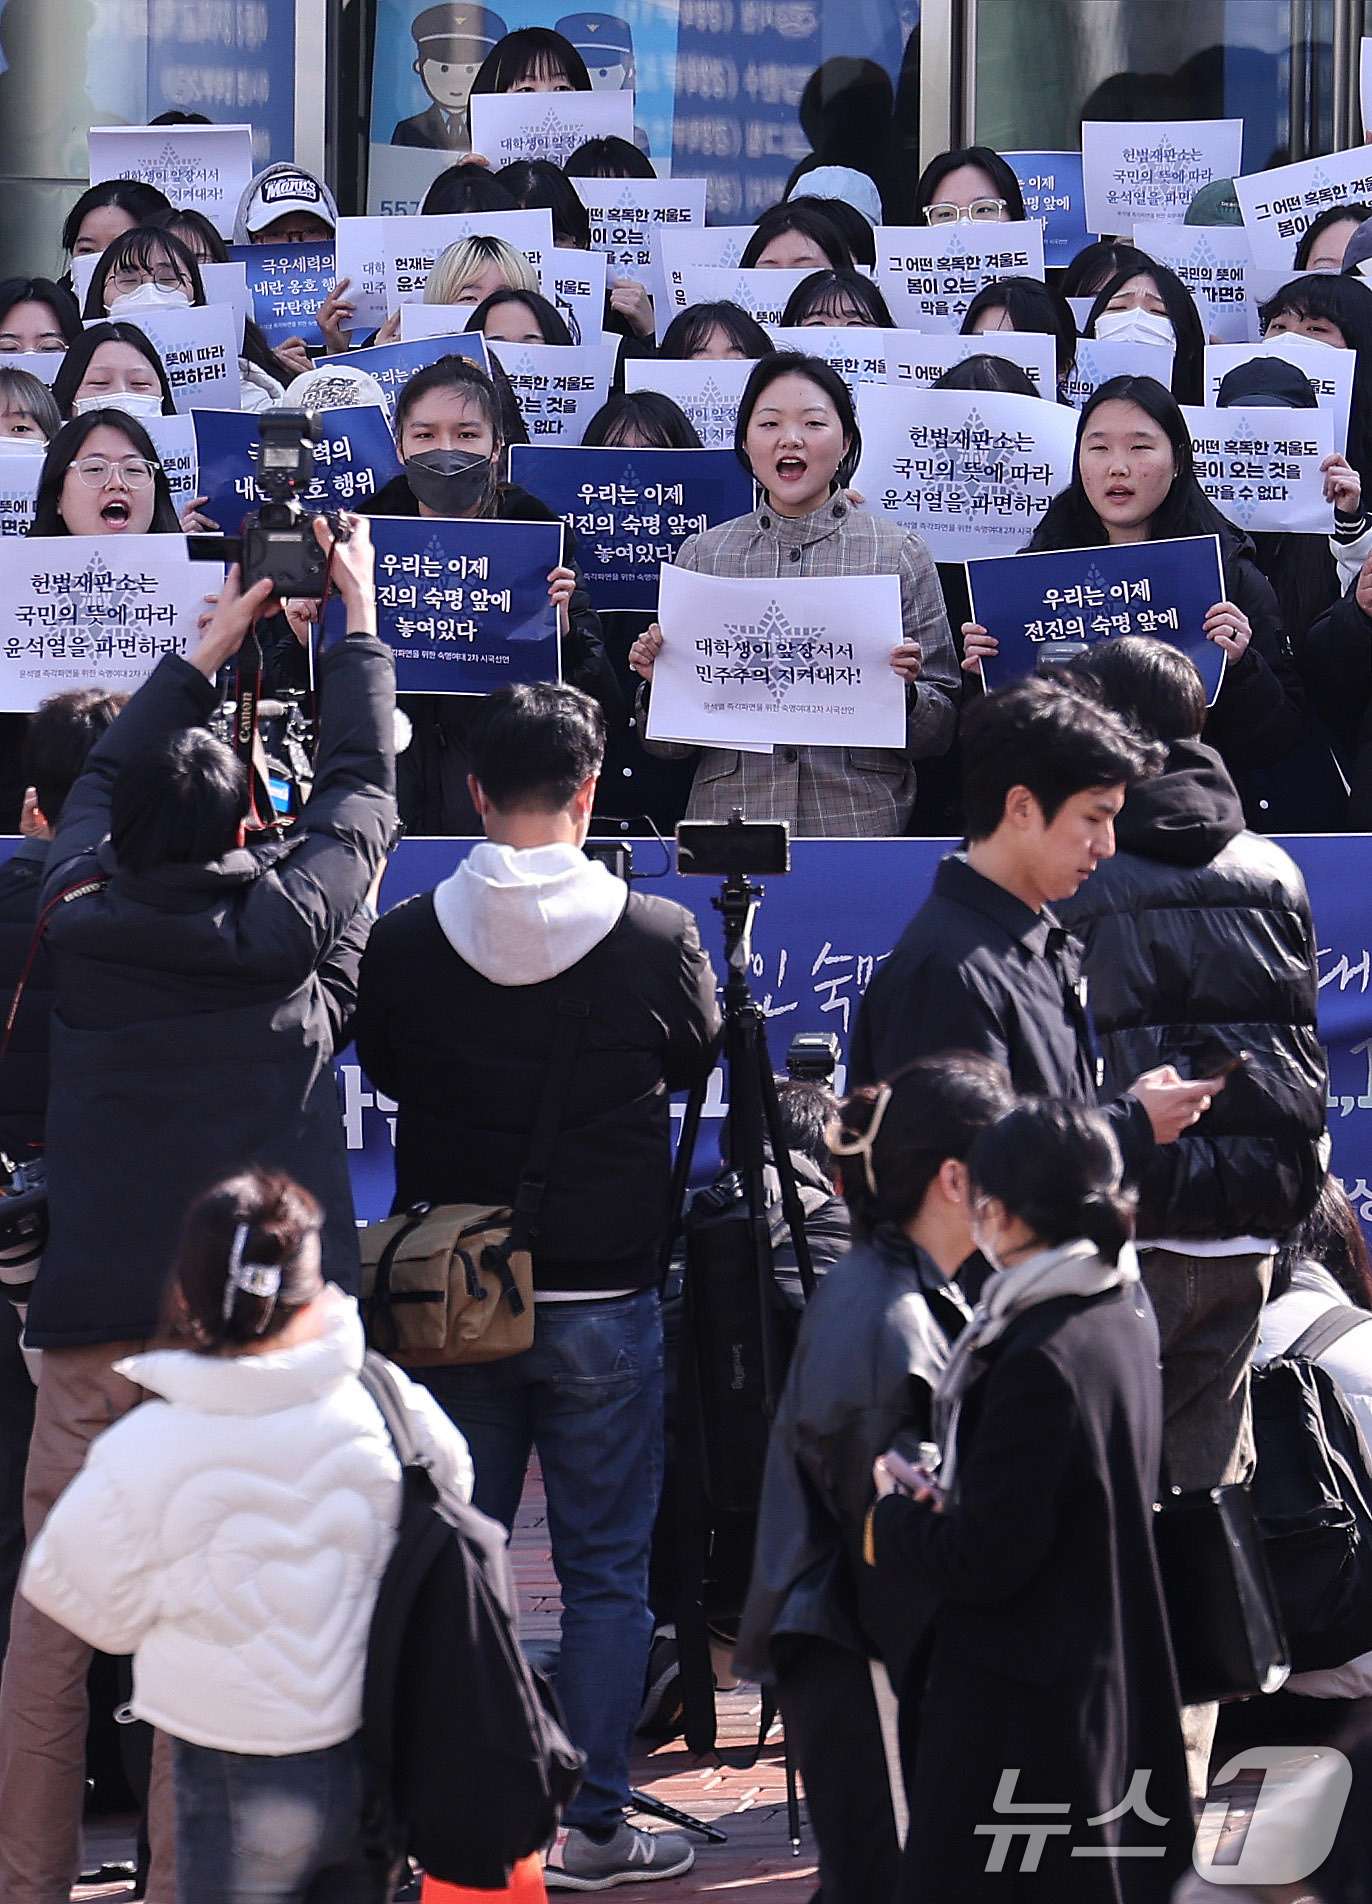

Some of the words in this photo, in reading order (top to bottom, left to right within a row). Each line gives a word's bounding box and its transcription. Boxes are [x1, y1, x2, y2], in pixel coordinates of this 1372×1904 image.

[501, 136, 548, 151] 대학생이
[552, 134, 600, 149] 앞장서
[1122, 148, 1204, 163] 헌법재판소는
[171, 169, 219, 183] 앞장서서
[1028, 175, 1055, 191] 이제
[1113, 170, 1153, 184] 국민의
[1158, 169, 1185, 184] 뜻에
[1188, 168, 1214, 183] 따라
[171, 187, 223, 201] 지켜내자!
[1043, 195, 1070, 211] 앞에
[1106, 191, 1162, 206] 윤석열을
[1255, 204, 1271, 221] 그
[1273, 196, 1302, 215] 어떤
[1304, 185, 1349, 207] 혹독한
[607, 208, 650, 223] 혹독한
[653, 208, 692, 223] 겨울도
[611, 228, 644, 245] 오는
[1277, 217, 1311, 239] 봄이
[262, 254, 335, 275] 극우세력의
[620, 251, 634, 264] 수
[889, 257, 902, 271] 그
[906, 256, 933, 271] 어떤
[936, 256, 981, 271] 혹독한
[985, 251, 1029, 268] 겨울도
[1178, 266, 1213, 281] 국민의
[1216, 267, 1244, 281] 뜻에
[254, 280, 285, 296] 내란
[287, 278, 318, 294] 옹호
[907, 277, 938, 294] 봄이
[942, 277, 977, 294] 오는
[921, 300, 949, 316] 막을
[165, 351, 193, 365] 뜻에
[196, 345, 226, 361] 따라
[167, 364, 227, 388] 면하라!
[898, 364, 912, 380] 그
[915, 365, 943, 381] 어떤
[553, 375, 595, 391] 겨울도
[546, 397, 577, 414] 것을
[533, 419, 563, 435] 없다
[908, 425, 1036, 453] 헌법재판소는
[1192, 439, 1220, 455] 어떤
[1223, 440, 1270, 456] 혹독한
[1274, 441, 1319, 456] 겨울도
[163, 456, 190, 471] 뜻에
[892, 457, 955, 482] 국민의
[961, 461, 1003, 484] 뜻에
[1011, 463, 1054, 487] 따라
[1229, 461, 1264, 479] 오는
[1269, 462, 1301, 480] 것을
[332, 467, 376, 498] 행위
[577, 482, 639, 506] 우리는
[643, 483, 684, 507] 이제
[1204, 485, 1235, 501] 막을
[1238, 486, 1254, 501] 수
[1257, 486, 1289, 501] 없다
[0, 500, 27, 513] 뜻에
[880, 489, 966, 514] 윤석열을
[970, 493, 1053, 517] 파면하라
[621, 514, 661, 536] 숙명
[668, 514, 708, 536] 앞에
[594, 543, 677, 564] 놓여있다
[379, 553, 444, 579] 우리는
[448, 555, 490, 581] 이제
[31, 572, 159, 595] 헌법재판소는
[422, 588, 464, 612] 숙명
[470, 589, 512, 613] 앞에
[1042, 584, 1106, 611] 우리는
[1109, 578, 1151, 604] 이제
[15, 604, 78, 626] 국민의
[86, 604, 126, 626] 뜻에
[135, 603, 178, 627] 따라
[395, 616, 478, 642] 놓여있다
[1023, 616, 1085, 642] 전진의
[1090, 611, 1132, 636] 숙명
[1137, 607, 1179, 632] 앞에
[3, 636, 90, 659] 윤석열을
[95, 636, 188, 659] 파면하라!
[695, 638, 770, 660] 대학생이
[777, 641, 854, 660] 앞장서서
[421, 650, 437, 660] 위한
[437, 651, 467, 663] 숙명여대
[467, 653, 479, 663] 2차
[480, 654, 510, 665] 시국선언
[19, 669, 42, 679] 윤석열
[82, 669, 97, 679] 위한
[98, 669, 128, 679] 숙명여대
[128, 669, 142, 678] 2차
[695, 665, 770, 685] 민주주의
[778, 666, 861, 686] 지켜내자!
[239, 692, 252, 743] Canon
[726, 702, 764, 712] 즉각파면을
[765, 703, 780, 713] 위한
[781, 704, 811, 713] 숙명여대
[812, 704, 824, 713] 2차
[825, 705, 855, 715] 시국선언
